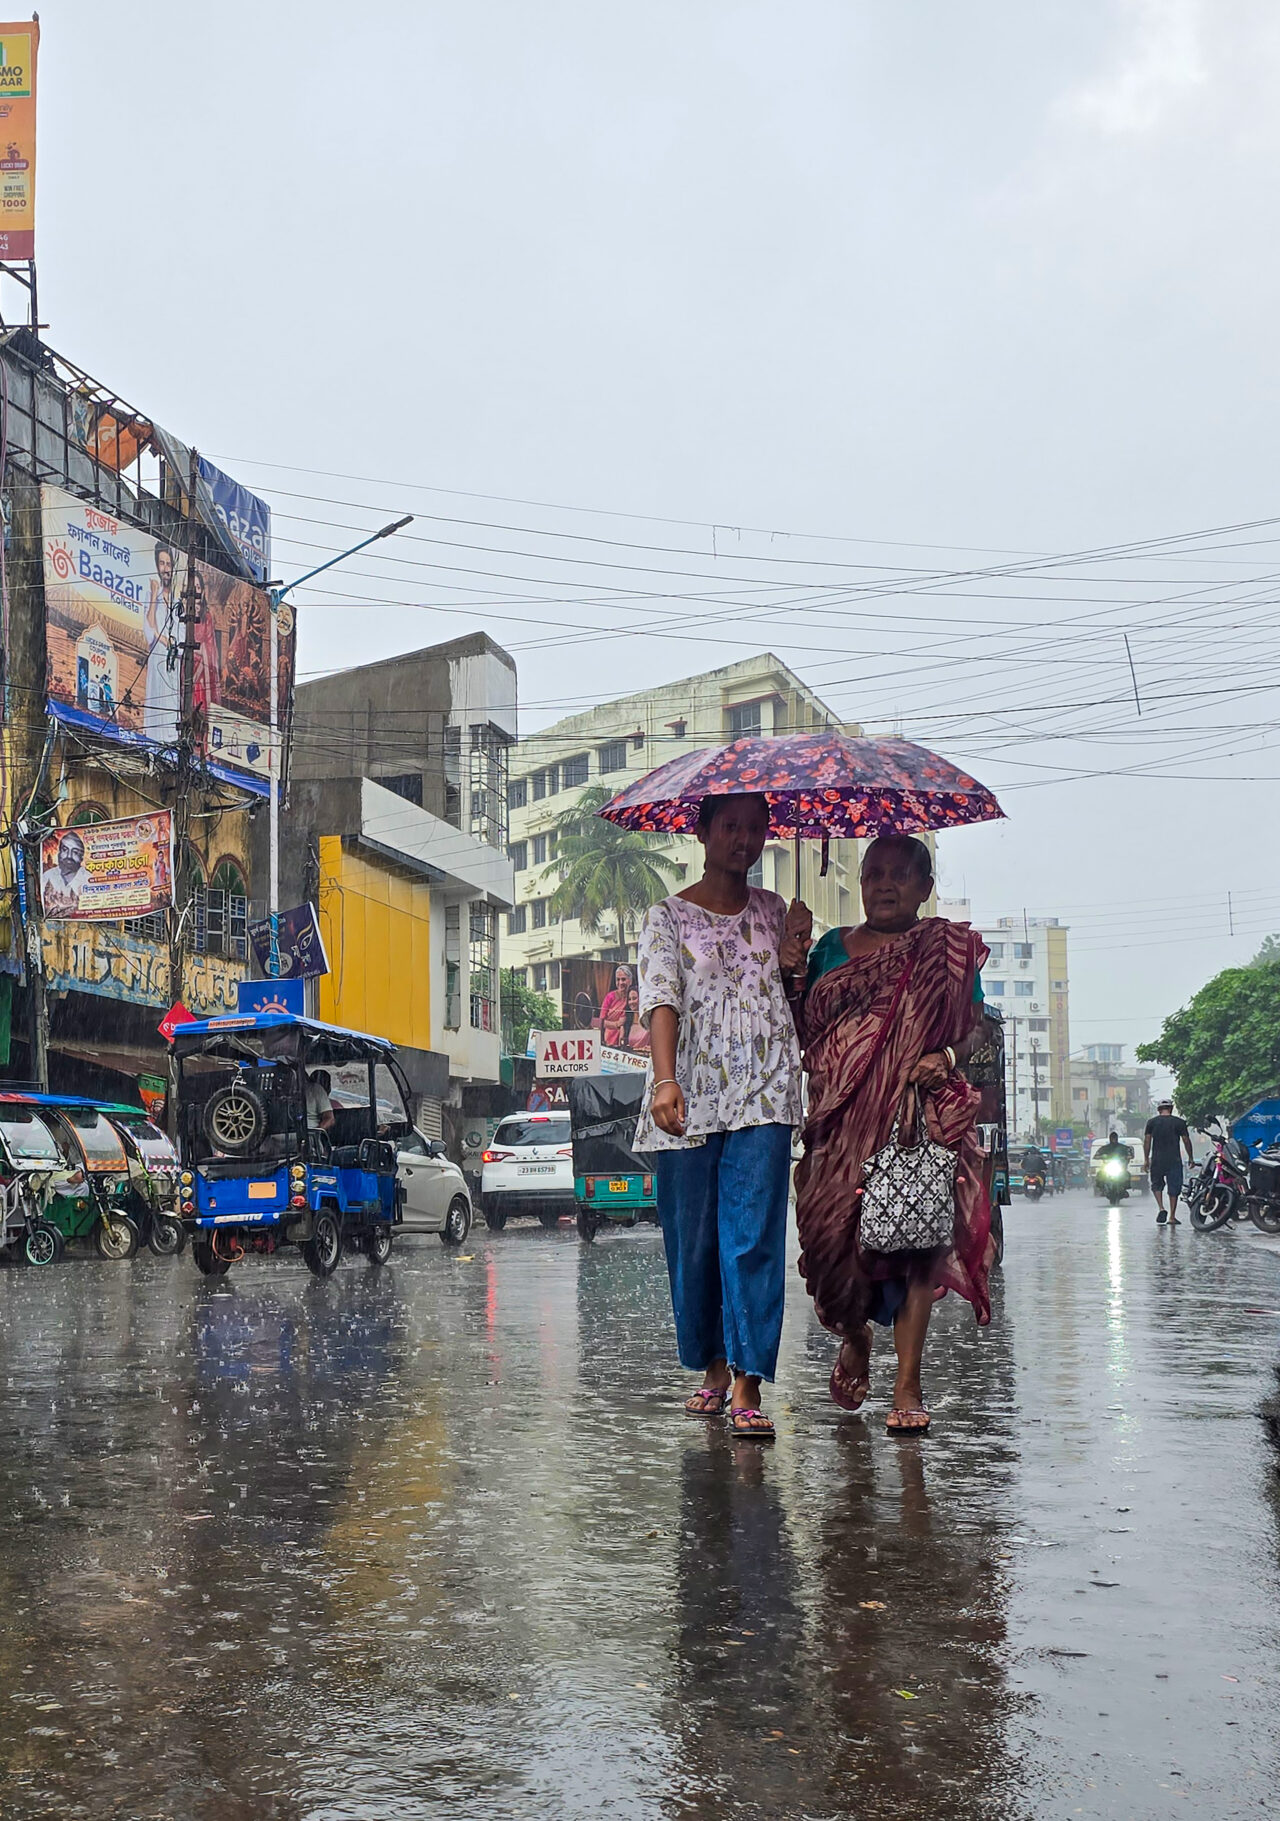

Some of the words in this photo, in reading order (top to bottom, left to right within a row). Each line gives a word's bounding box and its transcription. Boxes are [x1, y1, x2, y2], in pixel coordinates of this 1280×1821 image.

[85, 508, 118, 536] পুজোর
[215, 503, 269, 556] aazar
[67, 522, 100, 550] ফ্যাশন
[102, 540, 130, 567] মানেই
[80, 549, 143, 601] Baazar
[111, 592, 139, 614] Kolkata
[85, 857, 128, 873] কলকাতা
[128, 854, 149, 870] চলো
[543, 1039, 593, 1061] ACE
[621, 1054, 648, 1068] TYRES
[544, 1063, 589, 1073] TRACTORS
[545, 1086, 569, 1103] SA
